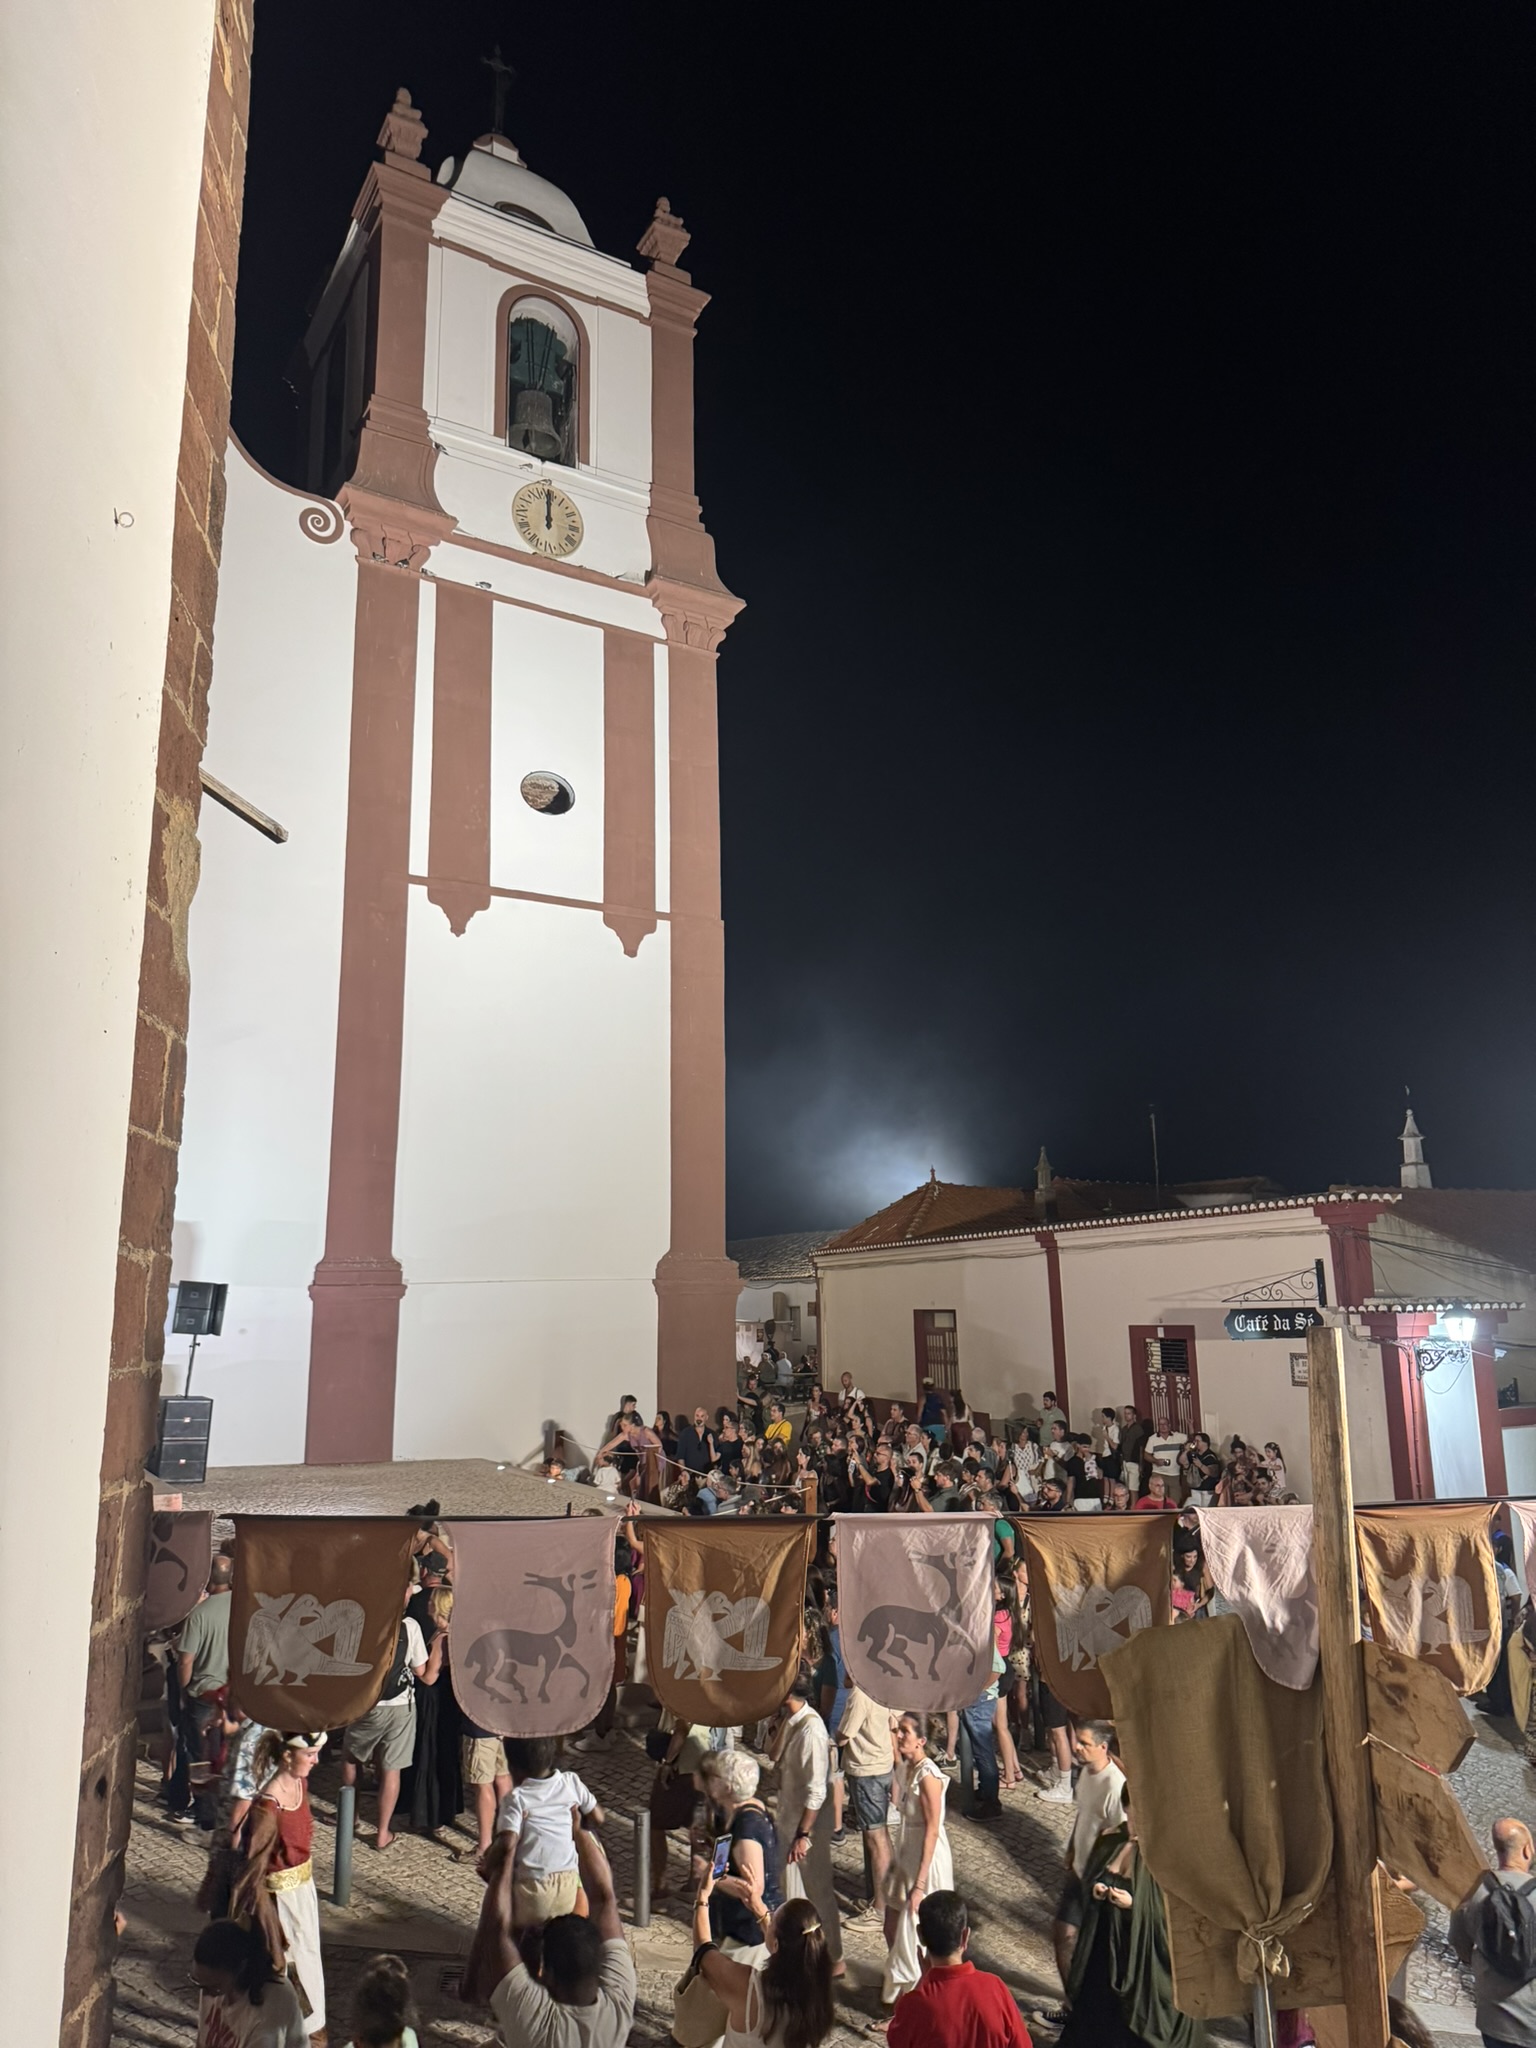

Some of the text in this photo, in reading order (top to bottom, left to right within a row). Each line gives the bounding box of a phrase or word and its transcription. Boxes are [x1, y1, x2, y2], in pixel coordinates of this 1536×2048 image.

[1234, 1313, 1314, 1332] Café da Sé
